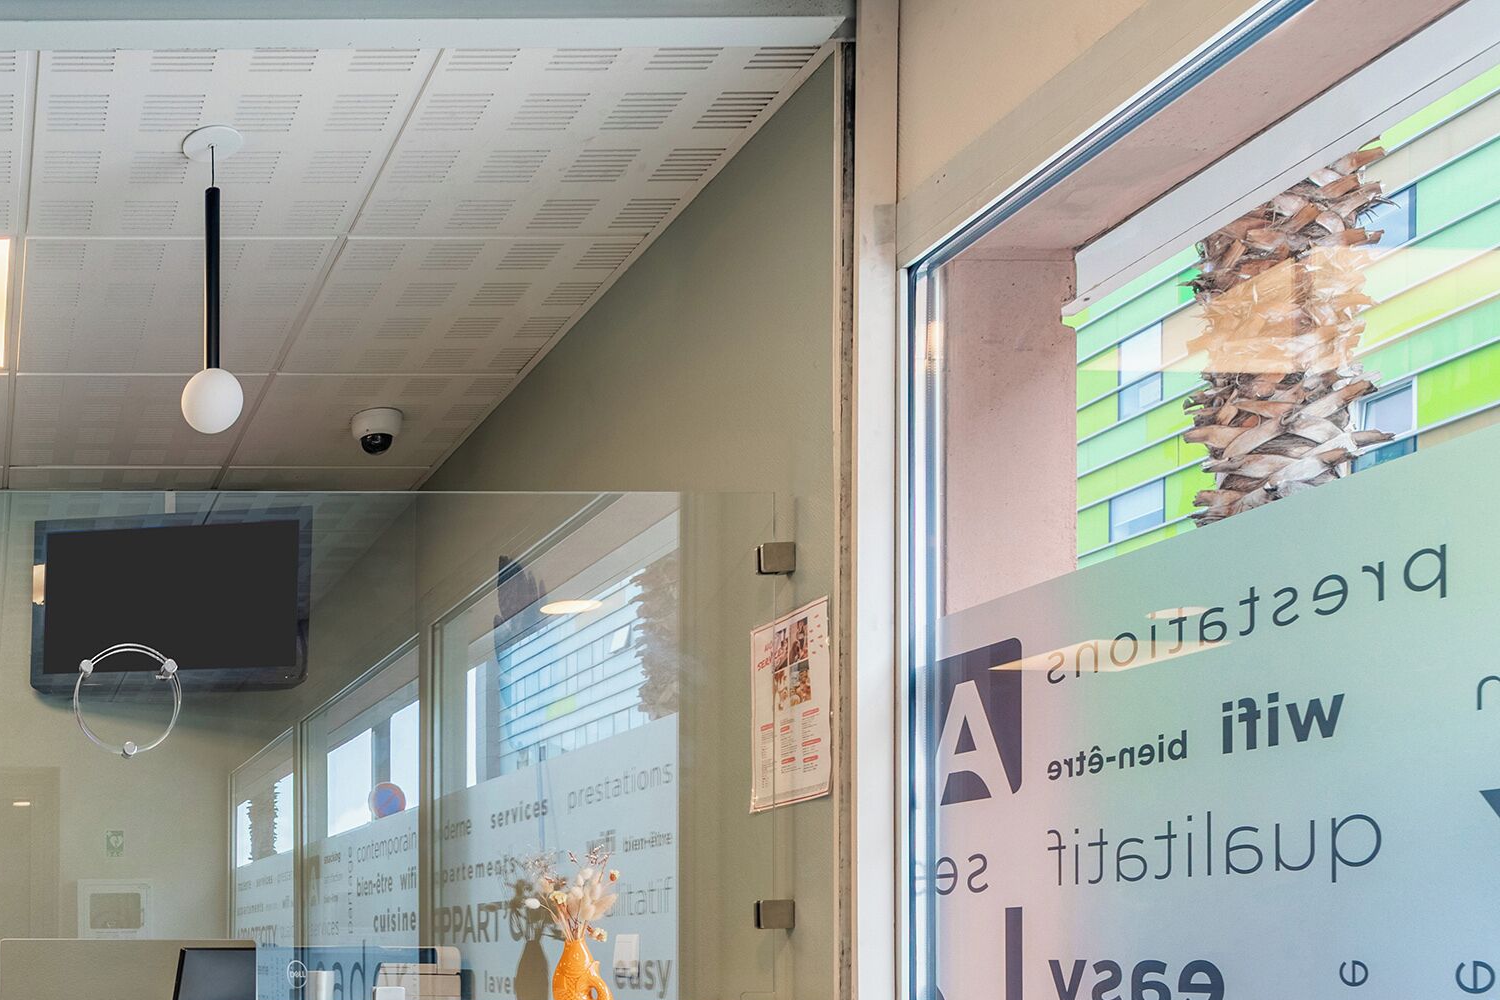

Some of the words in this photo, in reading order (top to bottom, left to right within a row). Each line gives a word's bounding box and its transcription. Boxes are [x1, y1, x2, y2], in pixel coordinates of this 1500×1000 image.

[566, 763, 673, 816] prestations
[443, 819, 472, 841] derne
[490, 799, 549, 830] services
[357, 826, 417, 863] contemporain
[356, 872, 393, 897] bien-être
[400, 866, 417, 890] wifi
[436, 857, 516, 885] partements
[373, 907, 417, 933] cuisine
[289, 970, 306, 979] DELL
